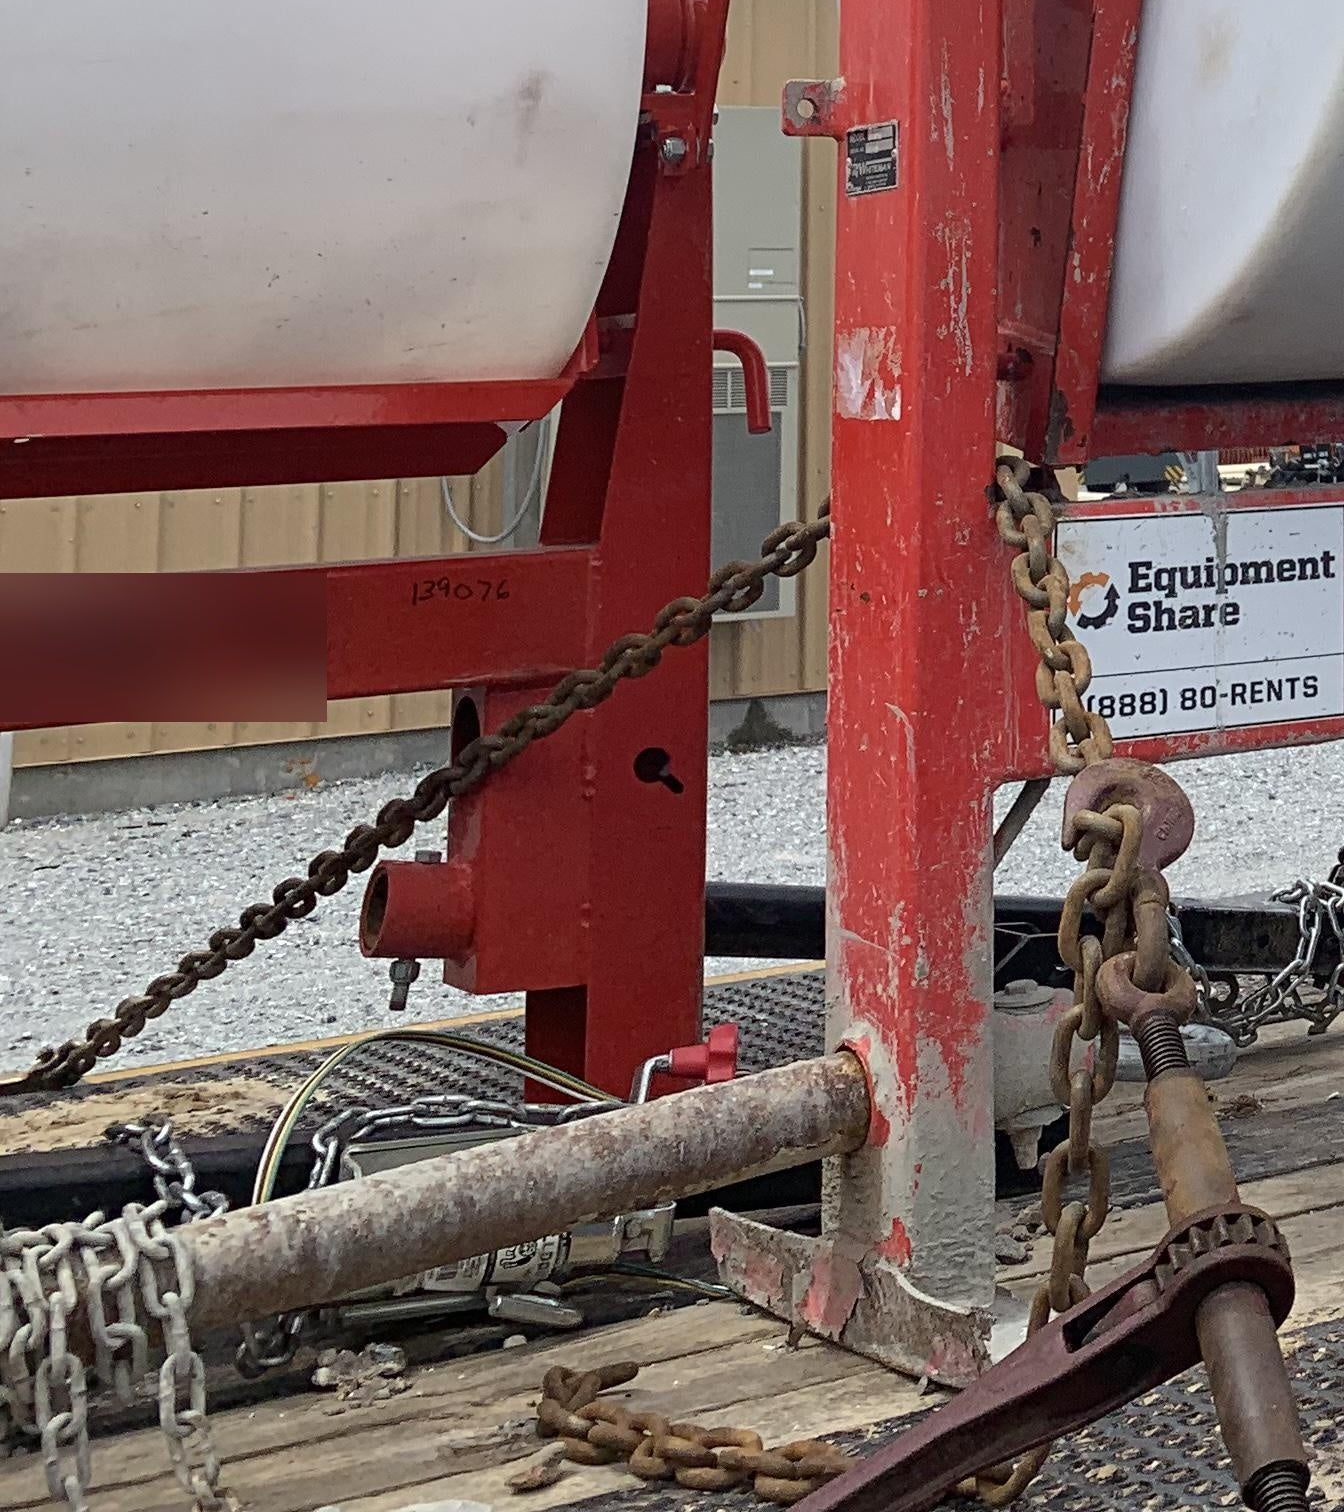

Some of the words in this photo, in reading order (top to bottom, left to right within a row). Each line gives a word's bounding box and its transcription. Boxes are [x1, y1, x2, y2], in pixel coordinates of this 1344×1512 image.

[411, 576, 511, 606] 139076
[1127, 550, 1336, 598] Equipment
[1127, 600, 1240, 634] Share
[1087, 688, 1168, 718] (888)
[1179, 675, 1319, 711] 80-RENTS
